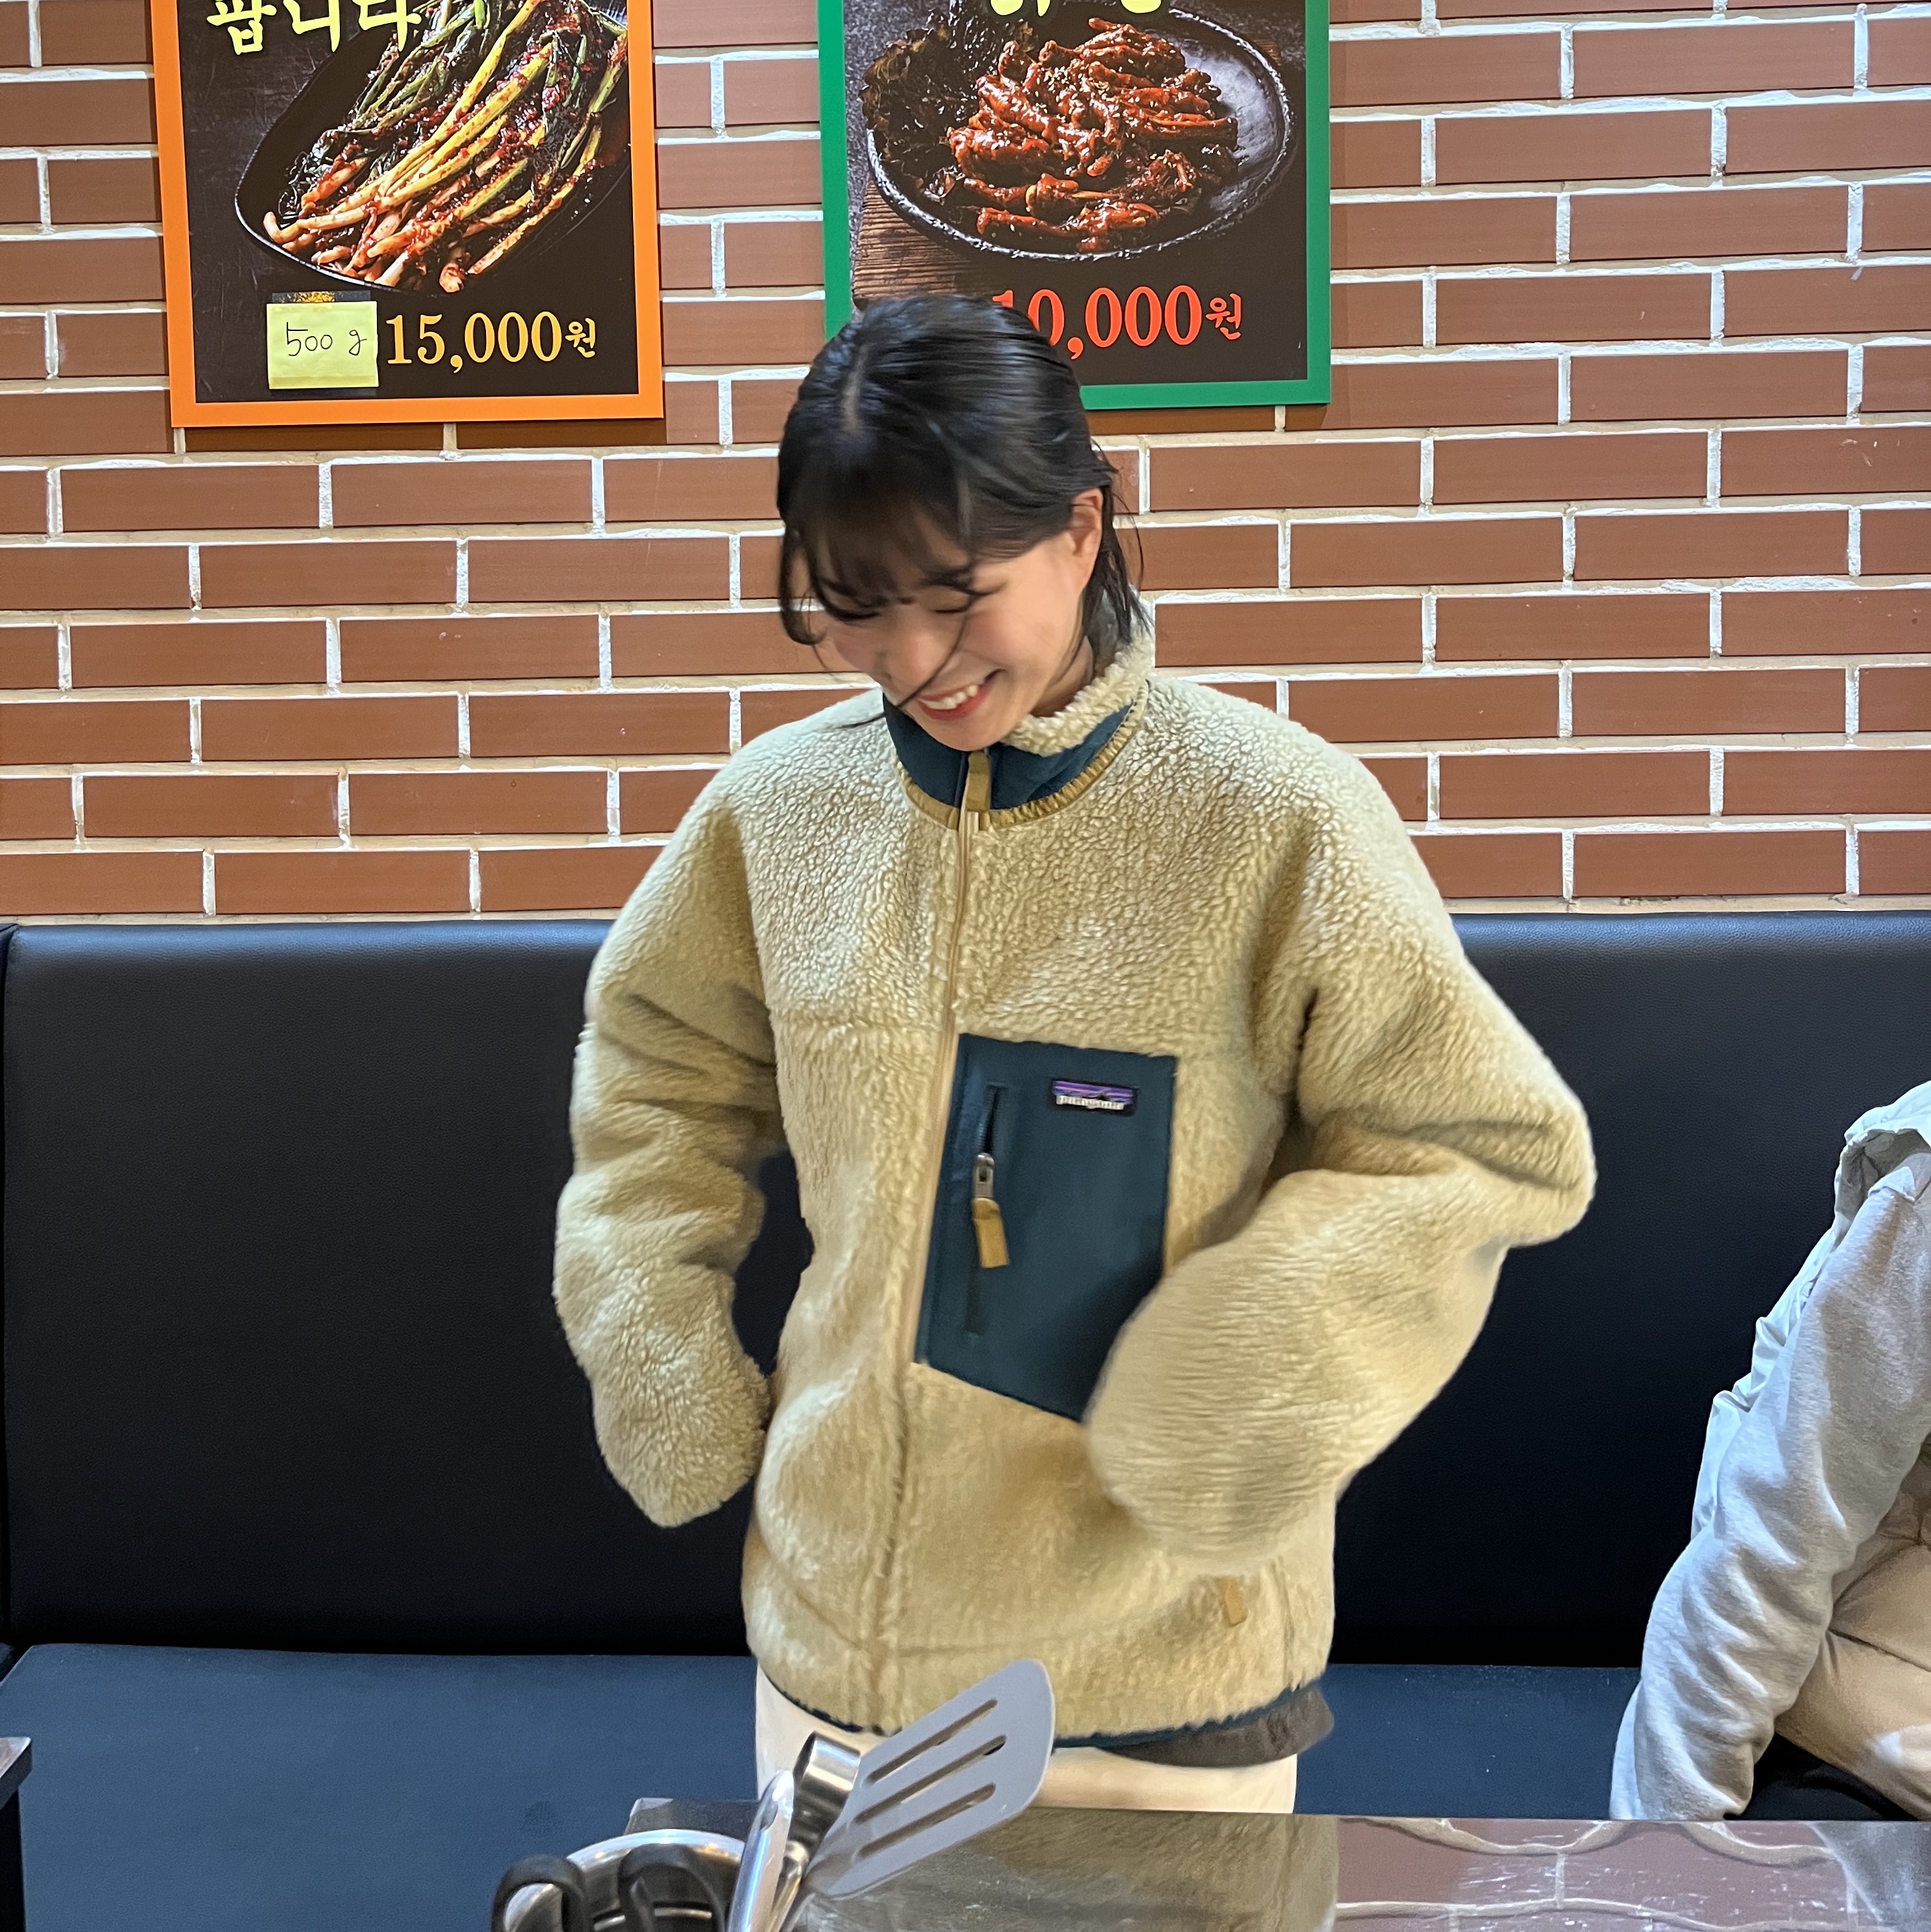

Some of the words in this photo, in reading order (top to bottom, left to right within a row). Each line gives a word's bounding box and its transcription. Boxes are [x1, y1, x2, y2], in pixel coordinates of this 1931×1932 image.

[286, 322, 333, 356] 500
[348, 329, 368, 356] g
[386, 311, 596, 373] 15,000원
